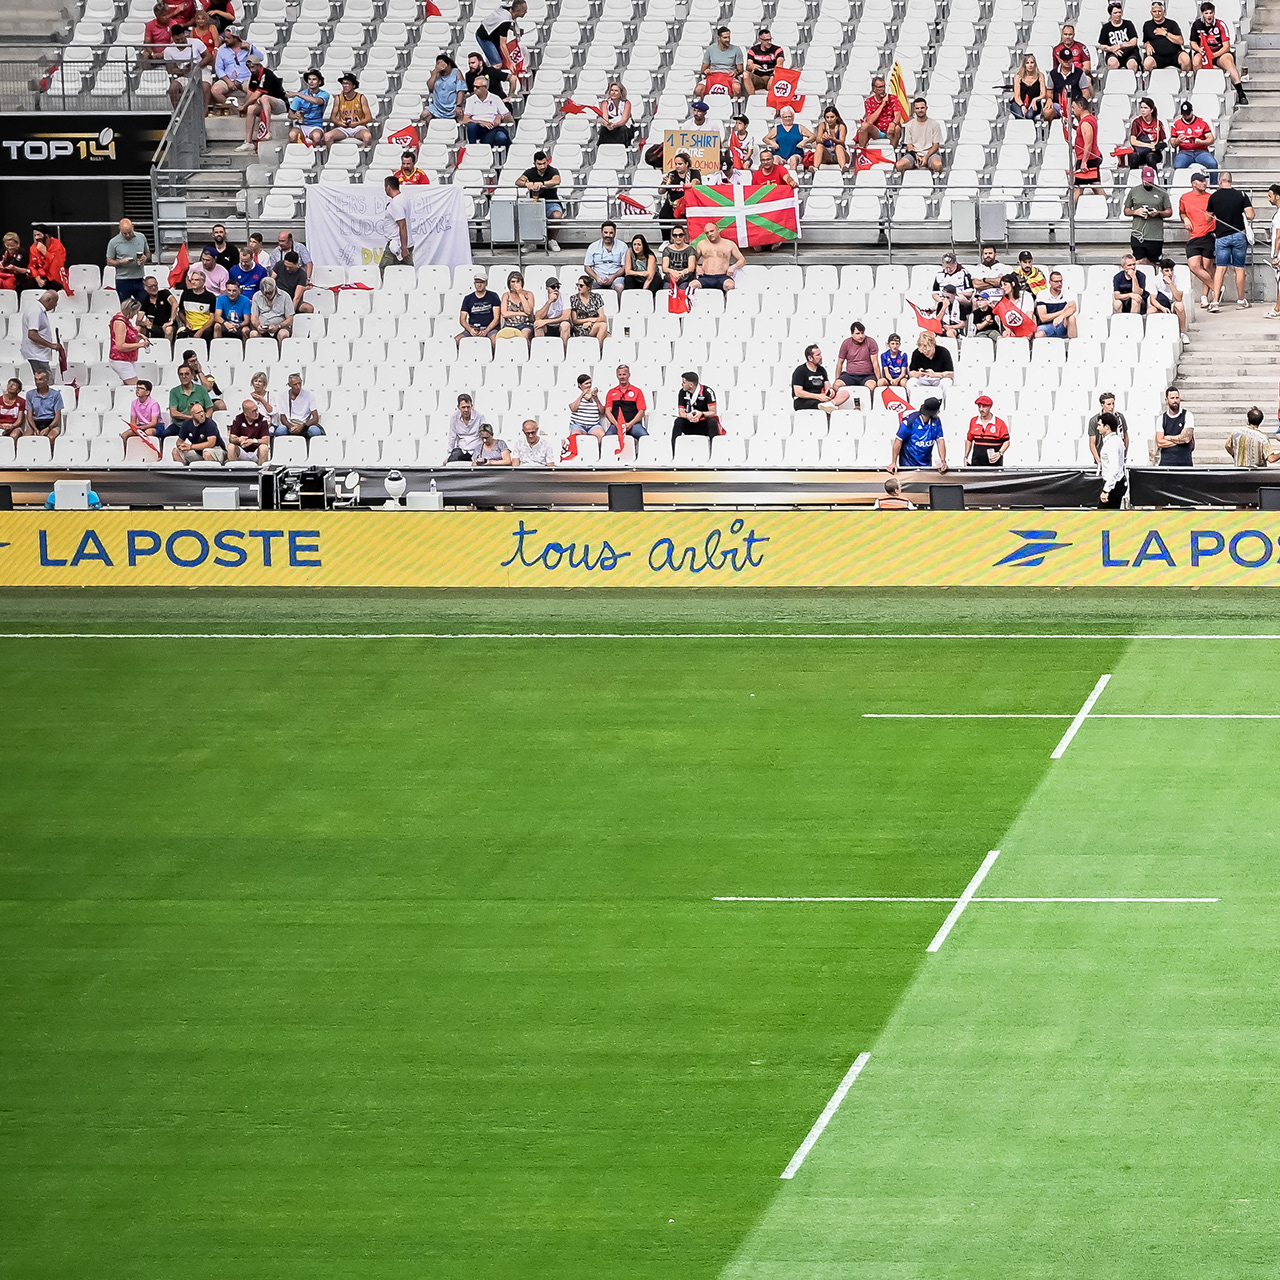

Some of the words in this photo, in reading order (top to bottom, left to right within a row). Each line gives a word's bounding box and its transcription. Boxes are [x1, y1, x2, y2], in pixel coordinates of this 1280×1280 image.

[680, 132, 719, 148] T-SHIRT
[39, 530, 112, 567] LA
[128, 529, 321, 568] POSTE
[502, 520, 630, 571] tous
[1102, 530, 1175, 567] LA
